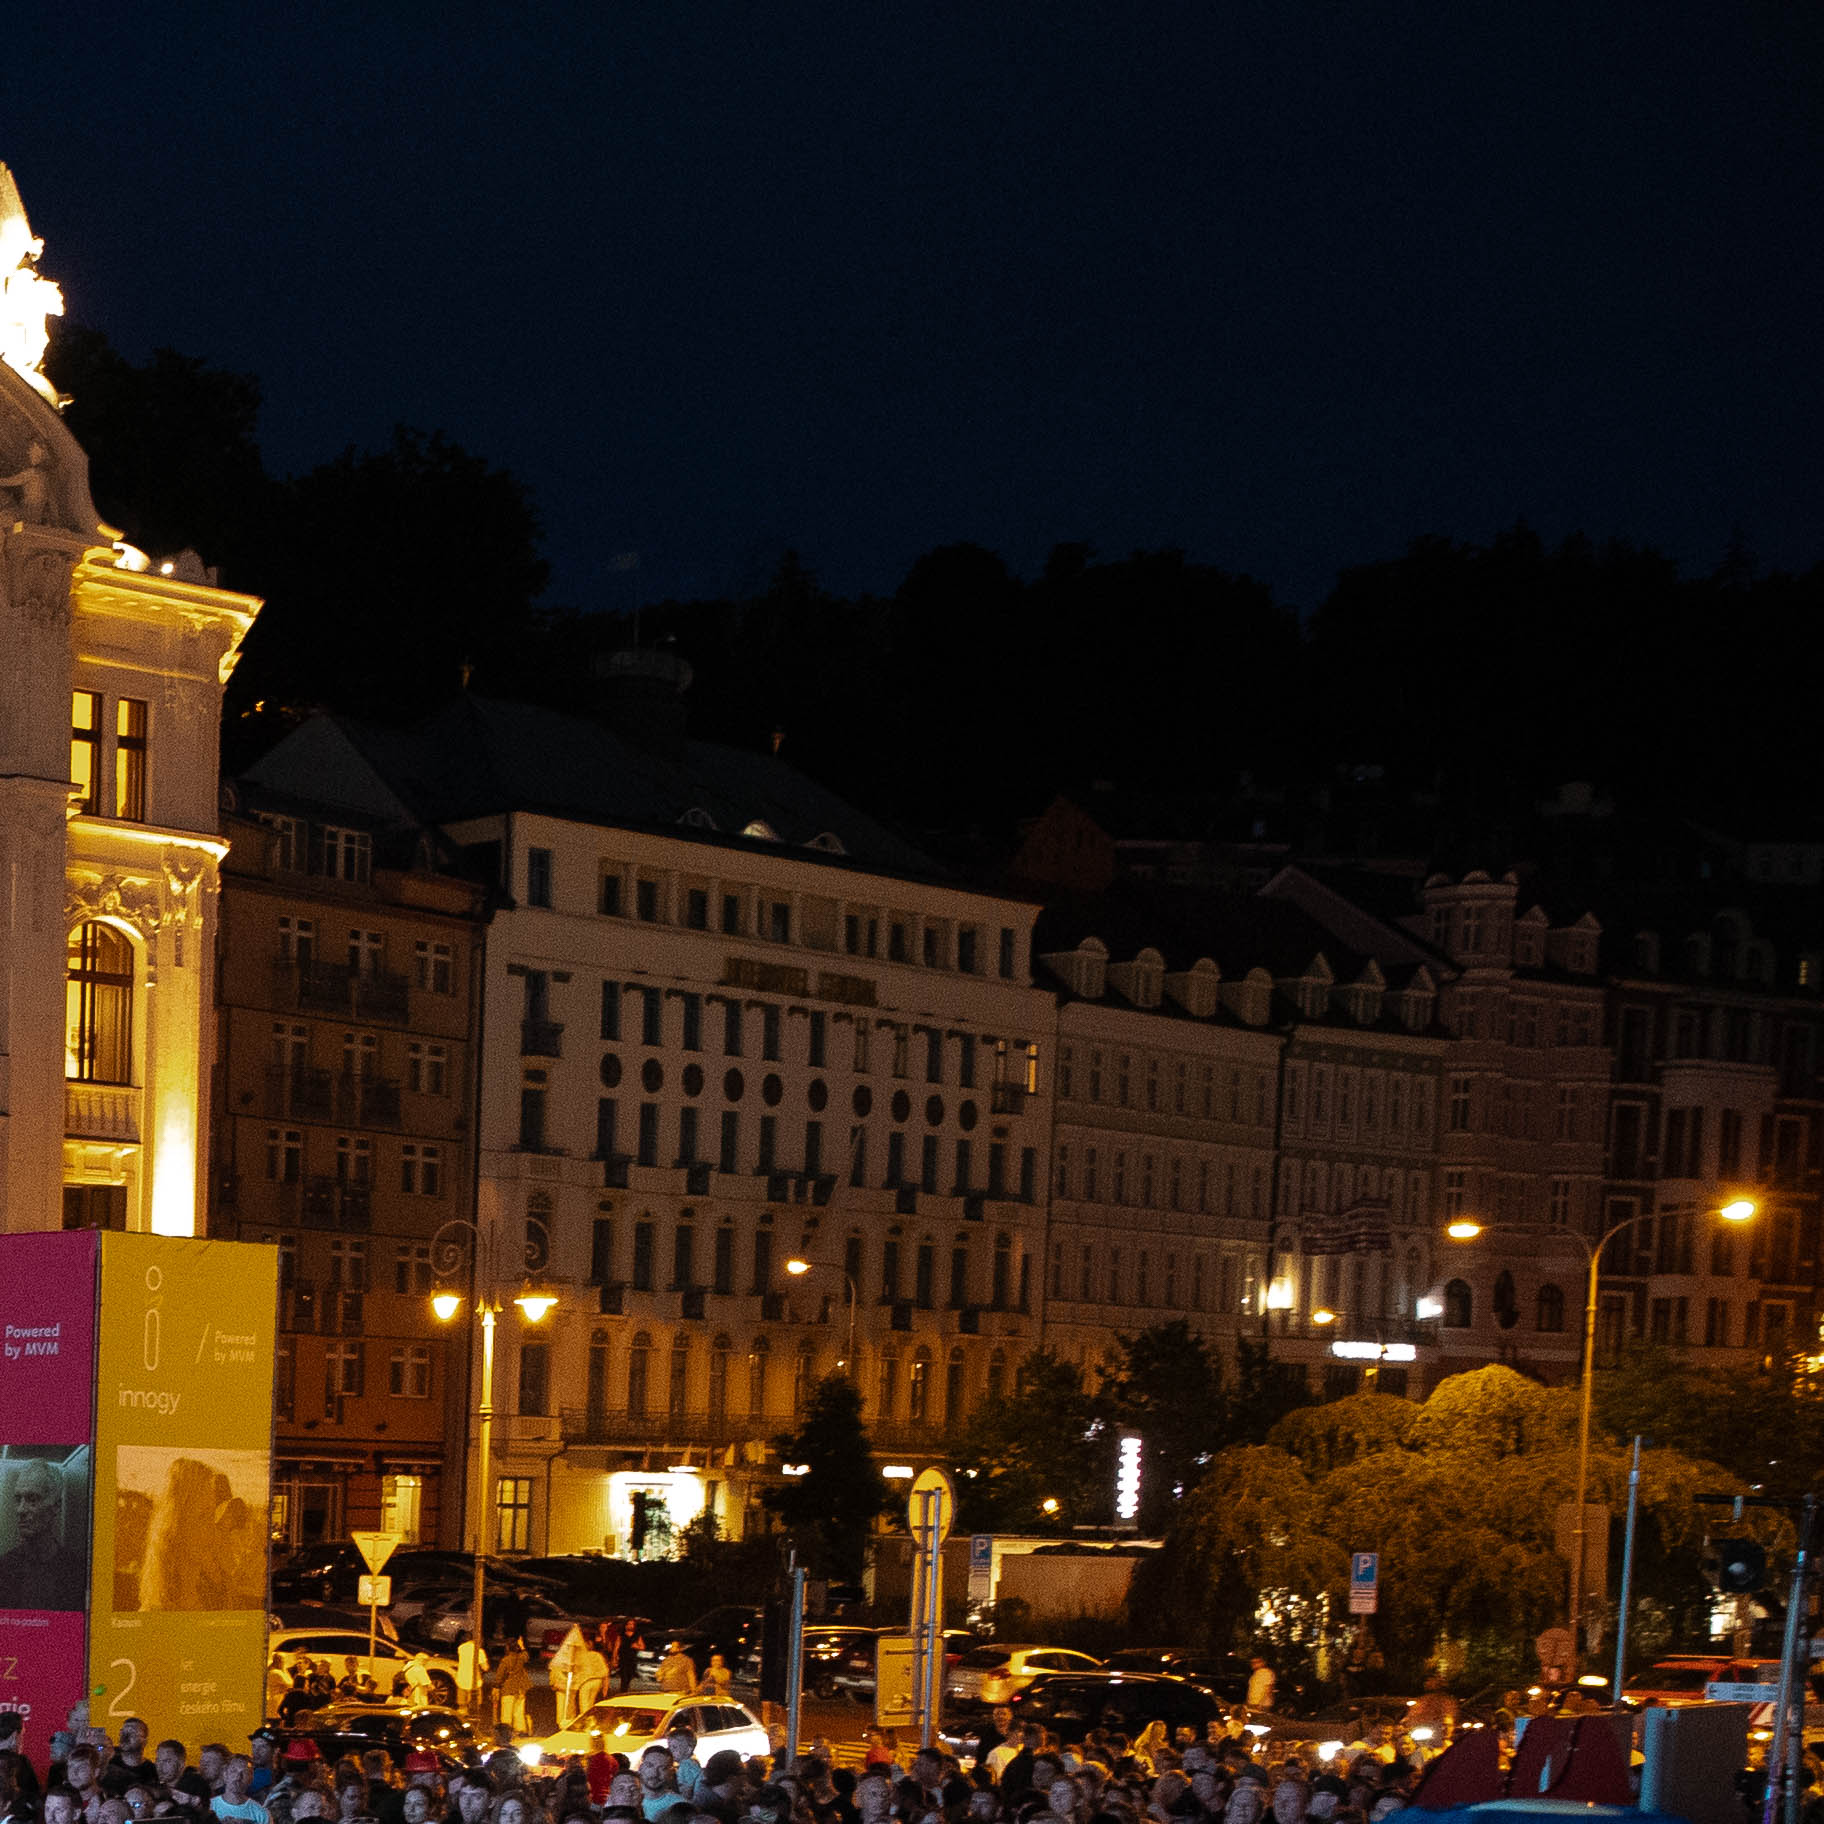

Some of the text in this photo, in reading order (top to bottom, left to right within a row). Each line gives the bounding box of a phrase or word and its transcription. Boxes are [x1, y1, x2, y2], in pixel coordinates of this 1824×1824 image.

[4, 1323, 61, 1339] Powered
[4, 1341, 60, 1360] by MVM
[118, 1382, 181, 1415] innogy
